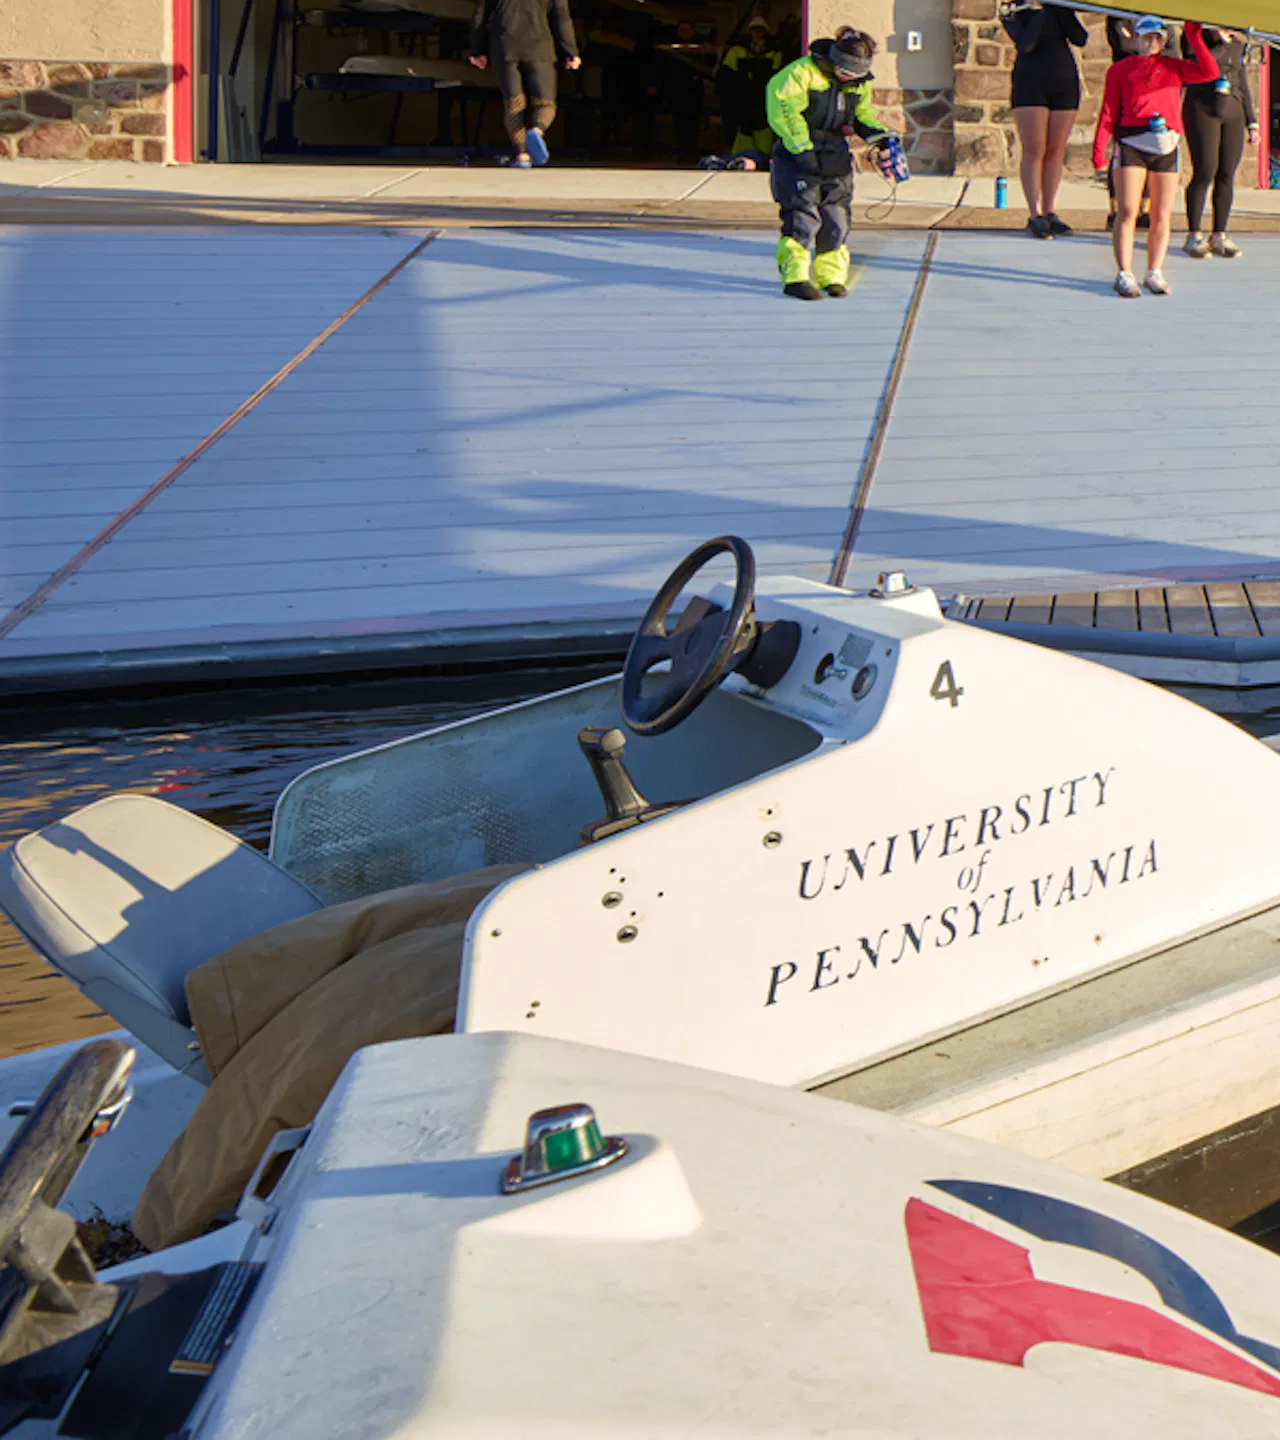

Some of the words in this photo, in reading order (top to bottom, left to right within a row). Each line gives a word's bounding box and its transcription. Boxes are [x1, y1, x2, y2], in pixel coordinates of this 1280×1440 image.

[930, 659, 964, 708] 4
[797, 766, 1116, 900] UNIVERSITY
[957, 849, 992, 893] of
[764, 838, 1160, 1007] PENNSYLVANIA
